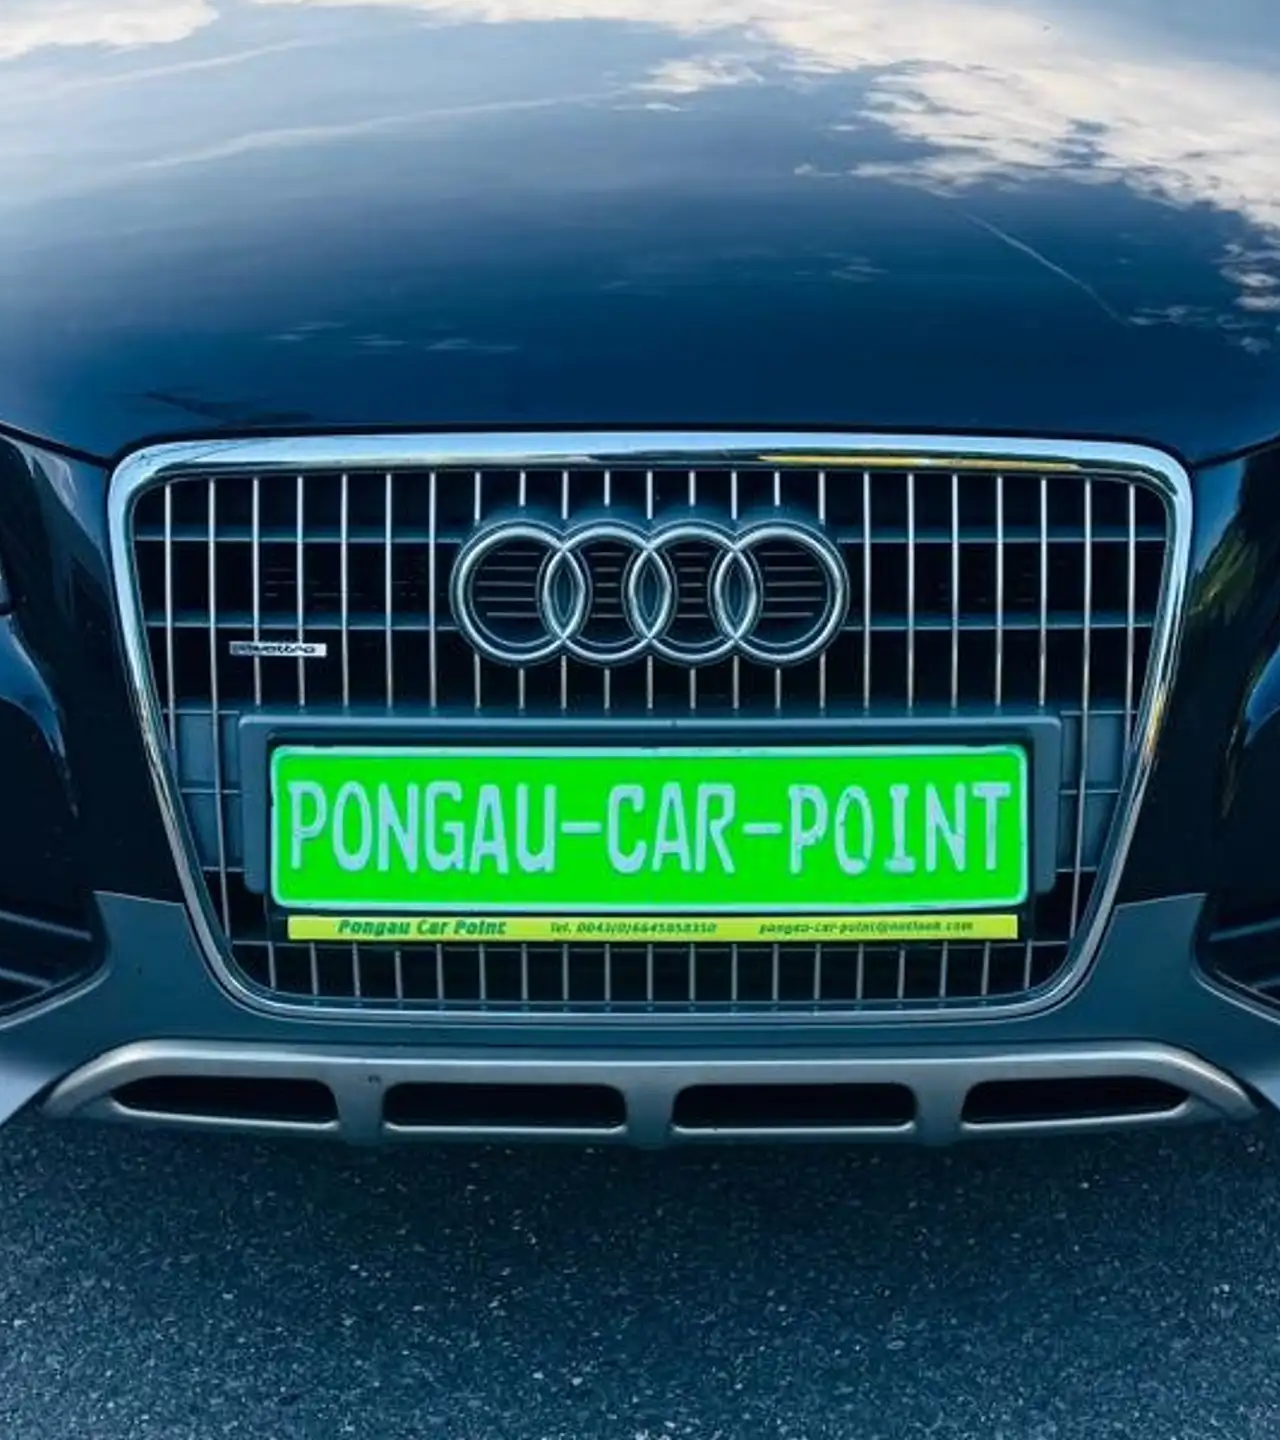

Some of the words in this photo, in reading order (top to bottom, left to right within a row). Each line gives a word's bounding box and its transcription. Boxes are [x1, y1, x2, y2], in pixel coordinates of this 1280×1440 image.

[287, 779, 1013, 874] PONGAU-CAR-POINT
[337, 919, 412, 936] Pongau
[416, 919, 448, 935] Car
[453, 919, 508, 935] Point
